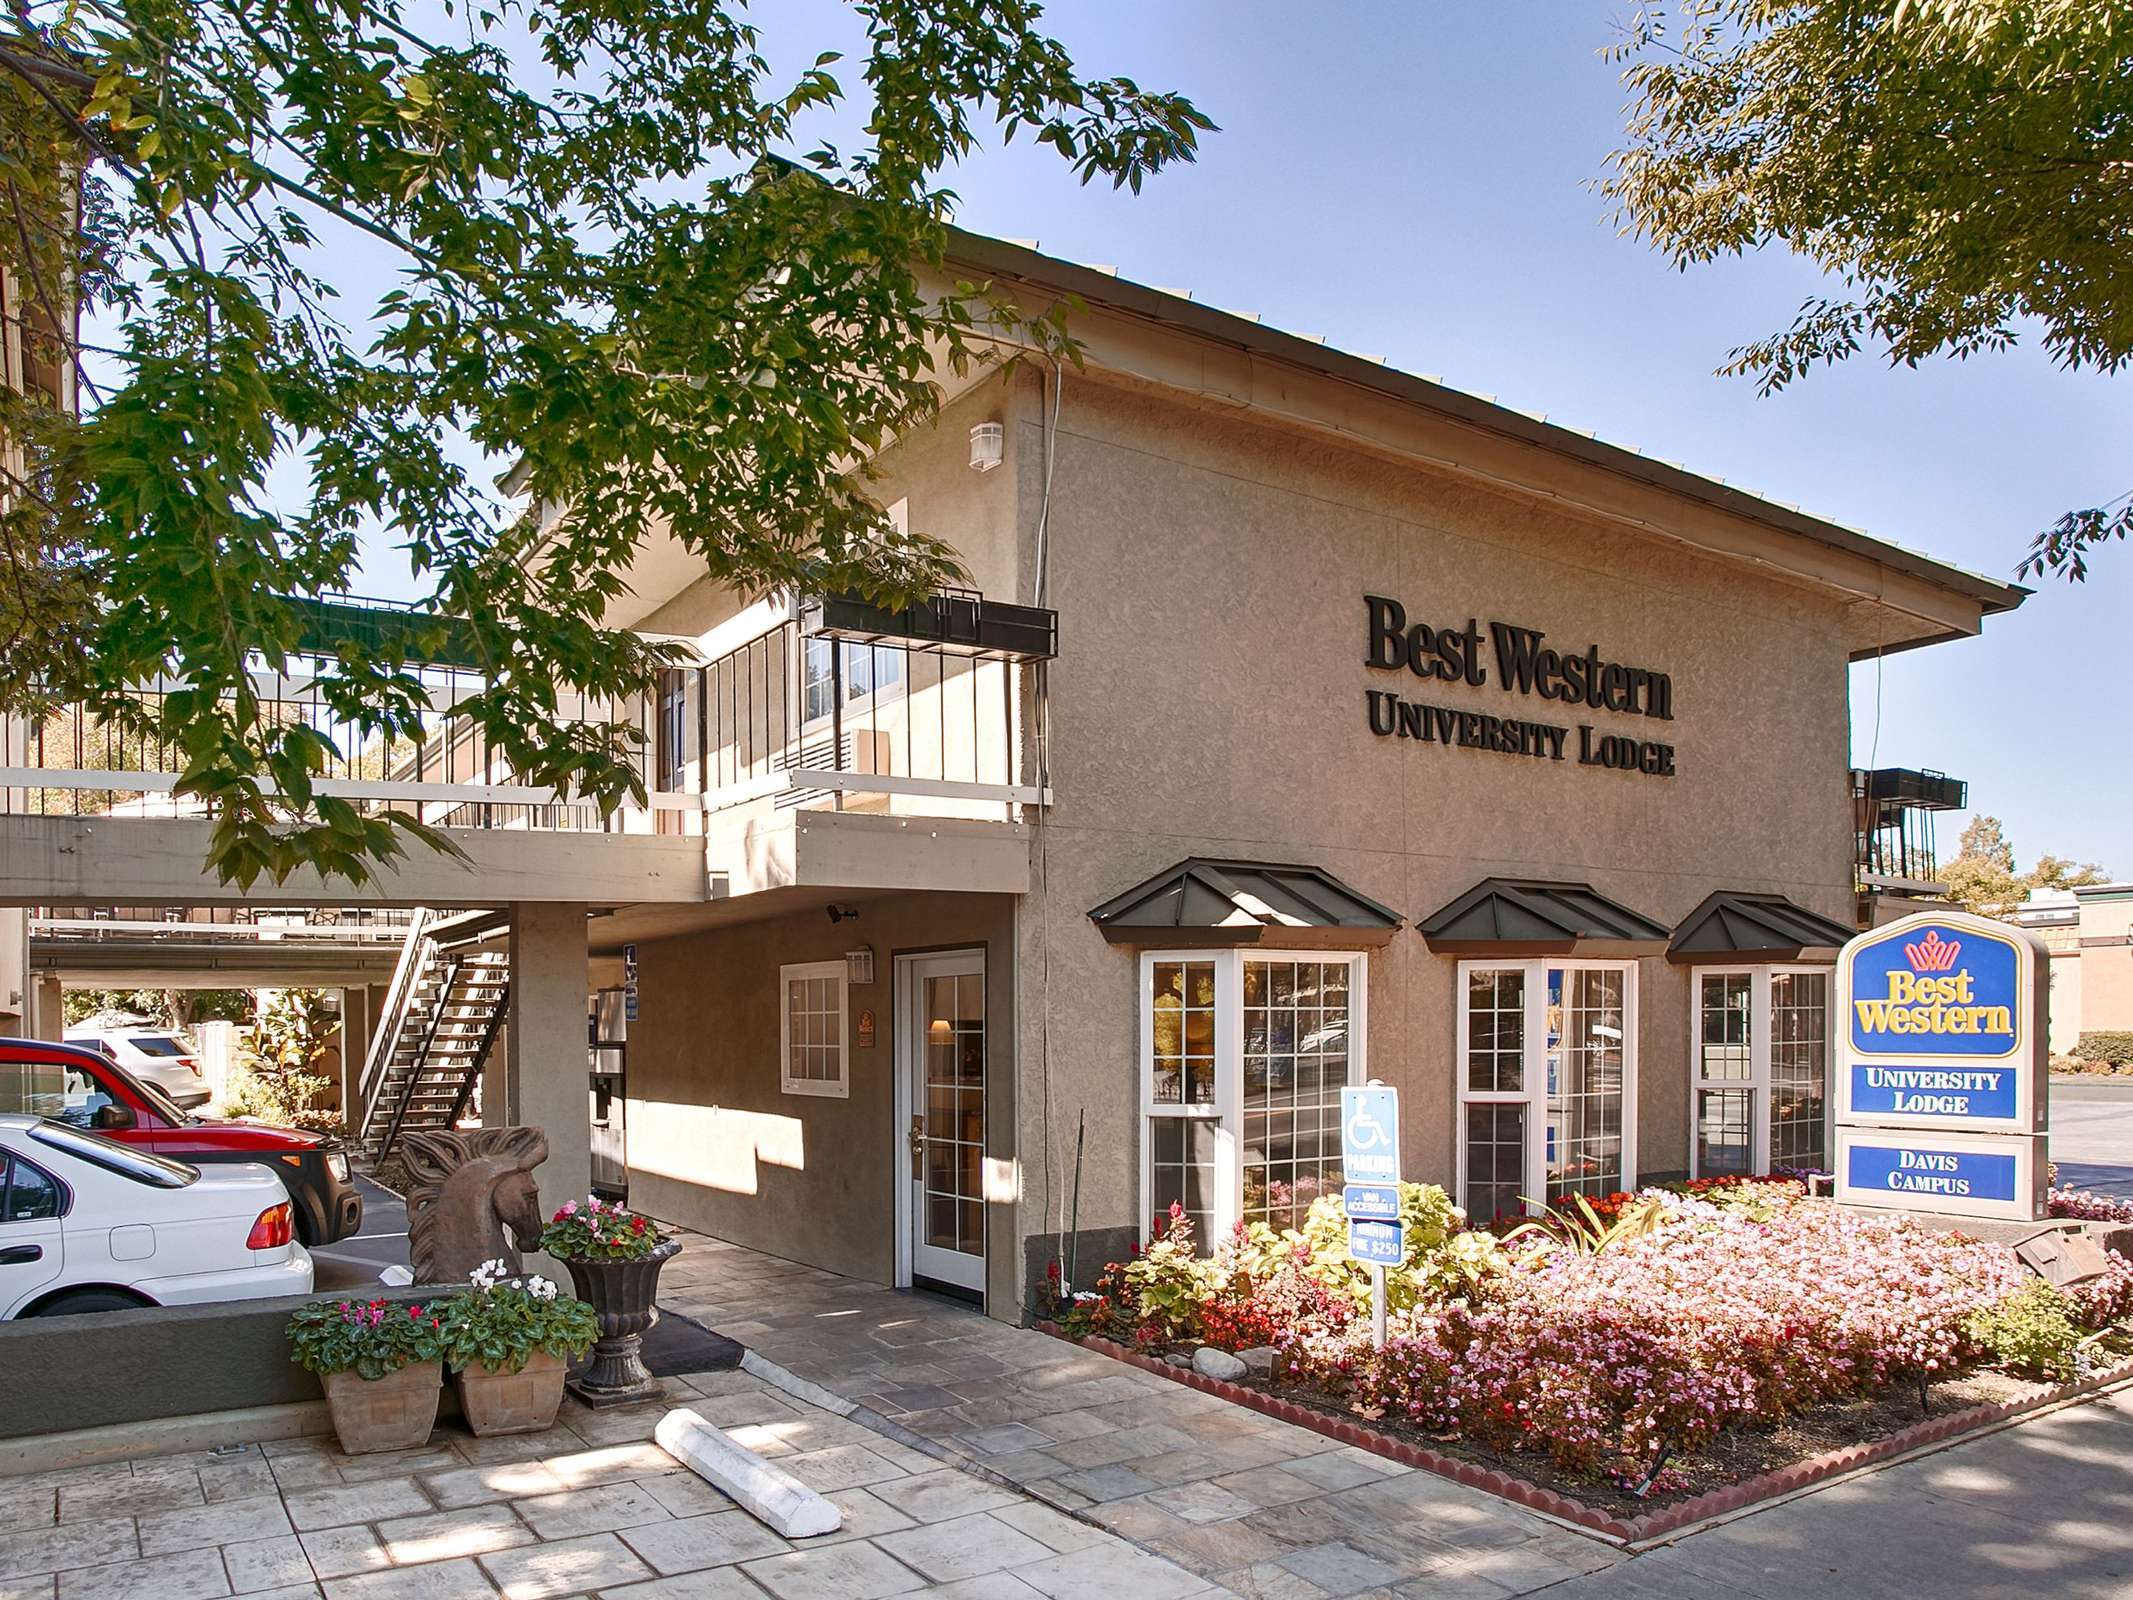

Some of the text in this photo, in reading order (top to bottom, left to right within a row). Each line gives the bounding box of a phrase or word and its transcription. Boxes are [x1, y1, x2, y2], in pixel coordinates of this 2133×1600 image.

[1363, 595, 1674, 720] Best Western
[1365, 689, 1676, 776] UNIVERSITY LODGE
[1886, 968, 1974, 1005] Best
[1854, 1000, 2013, 1035] Western
[1866, 1068, 2001, 1091] UNIVERSITY
[1893, 1092, 1969, 1115] LODGE
[1899, 1151, 1959, 1172] DAVIS
[1888, 1172, 1970, 1195] CAMPUS
[1348, 1201, 1396, 1213] ACCESSIBLE
[1362, 1191, 1380, 1203] VAN
[1371, 1240, 1399, 1256] $250
